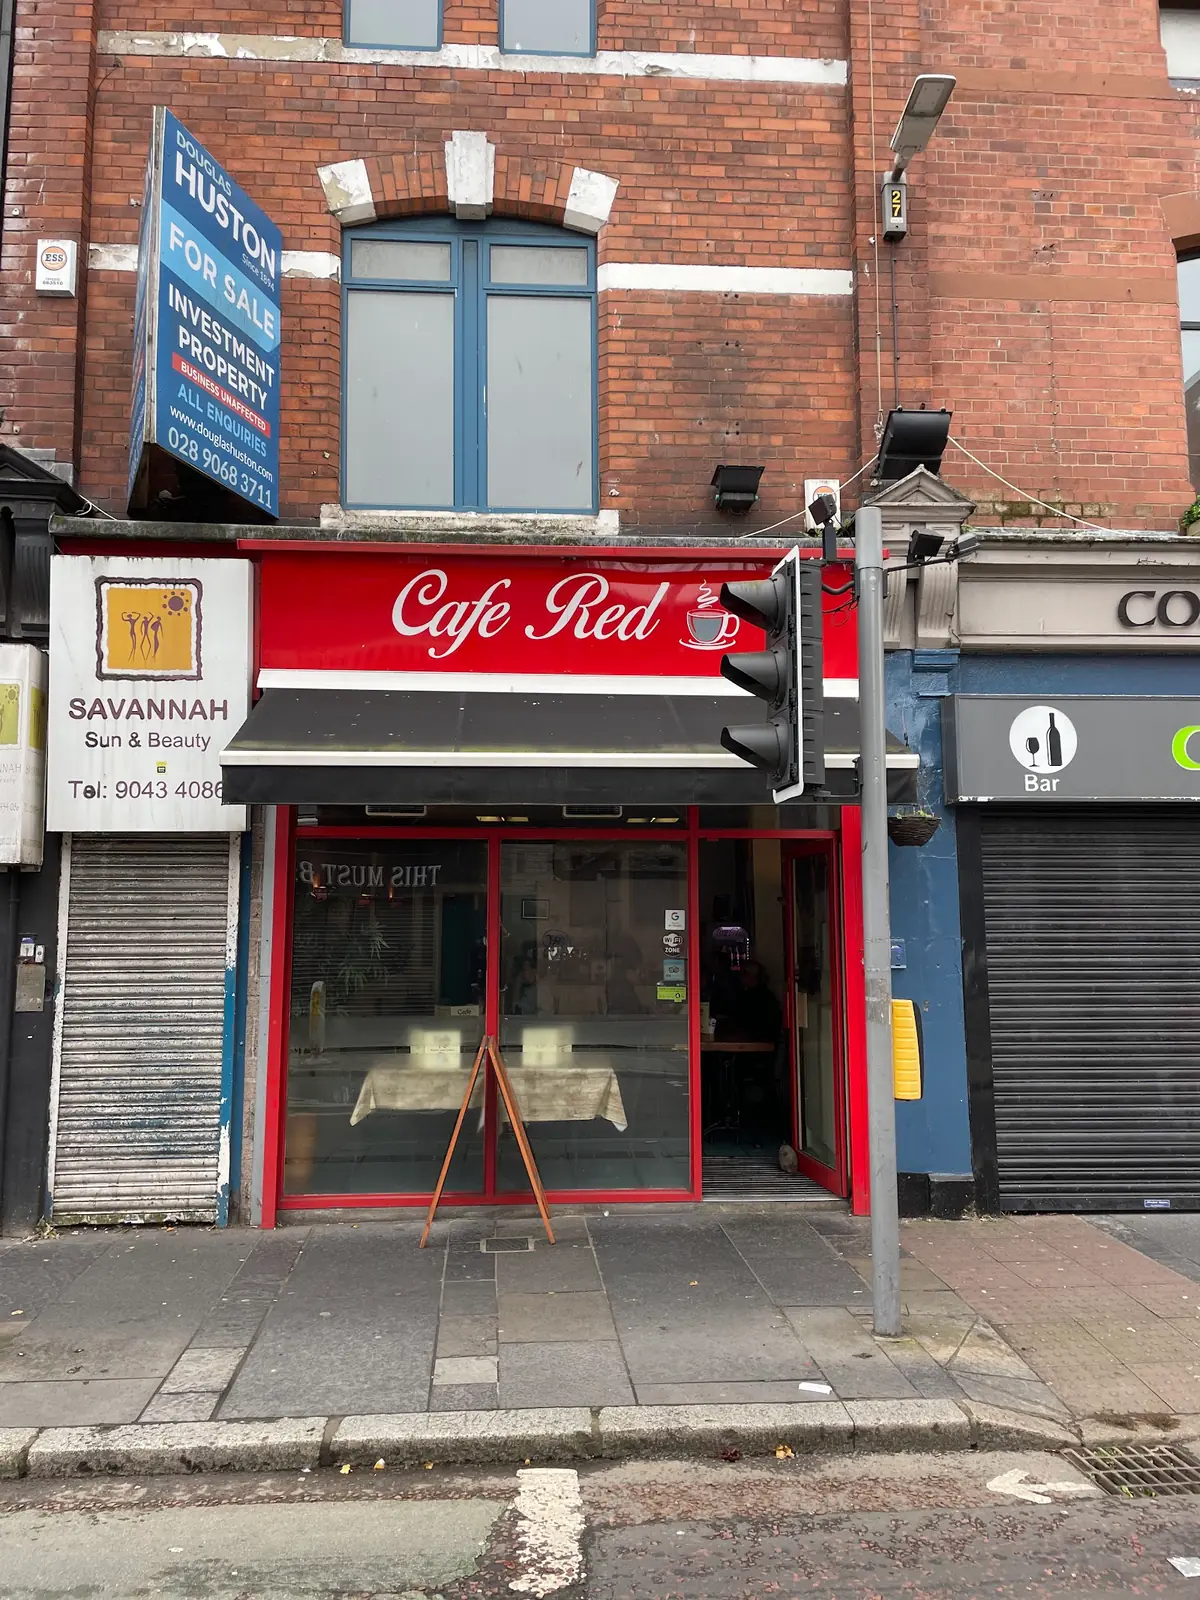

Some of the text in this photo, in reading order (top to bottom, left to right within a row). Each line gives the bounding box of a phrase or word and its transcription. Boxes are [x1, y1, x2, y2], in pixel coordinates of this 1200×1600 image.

[176, 129, 232, 196] DOUGLAS
[175, 150, 275, 279] HUSTON
[893, 191, 901, 217] 27
[45, 253, 63, 261] ESS
[169, 221, 275, 340] FOR SALE
[241, 252, 275, 292] Since 1894
[168, 283, 275, 387] INVESTMENT
[178, 324, 268, 411] PROPERTY
[177, 383, 267, 458] ALL ENQUIRIES
[181, 361, 266, 431] BUSINESS UNAFFECTED
[168, 426, 272, 509] 028 9068 3711
[169, 405, 273, 483] www.douglashuston.com
[391, 569, 670, 659] Cafe Red
[1117, 590, 1200, 628] CO
[68, 697, 228, 721] SAVANNAH
[85, 731, 211, 752] Sun & Beauty
[68, 780, 107, 799] Tel:
[115, 781, 168, 799] 9043
[1024, 774, 1060, 792] Bar
